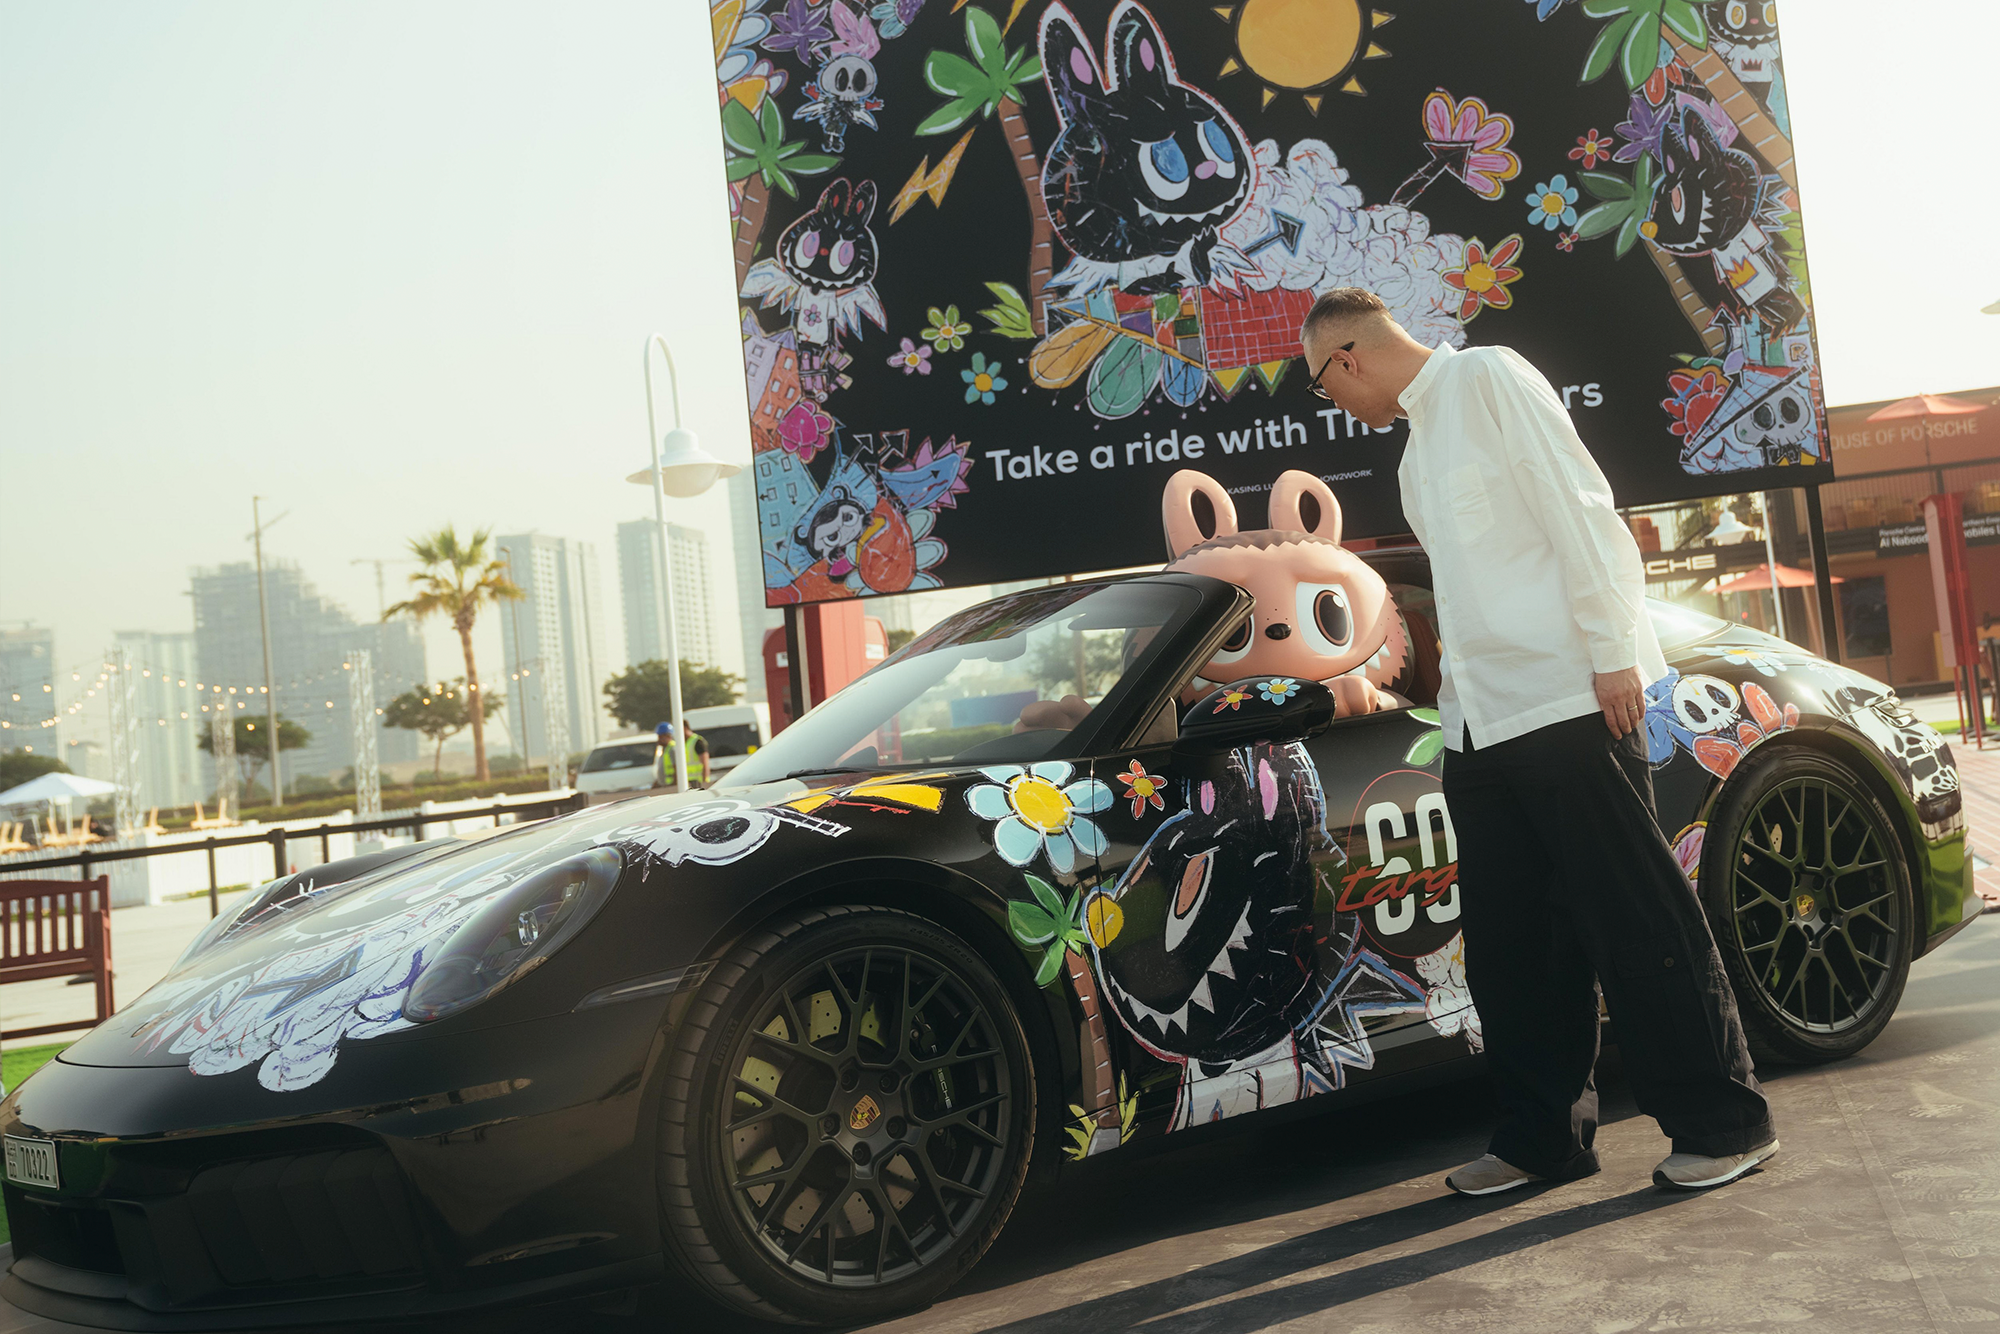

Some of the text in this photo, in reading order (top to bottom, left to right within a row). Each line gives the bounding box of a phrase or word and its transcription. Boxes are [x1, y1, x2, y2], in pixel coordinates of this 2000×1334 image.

[985, 445, 1079, 481] Take
[1090, 444, 1115, 470] a
[1125, 429, 1205, 466] ride
[1217, 415, 1308, 455] with
[1316, 408, 1394, 441] Th
[1830, 417, 1979, 451] OUSE OF PORSCHE
[1264, 482, 1275, 491] LU
[1891, 532, 1930, 547] Nabood
[1963, 526, 1995, 538] obiles
[1643, 553, 1717, 575] CHE
[1336, 862, 1458, 913] targ
